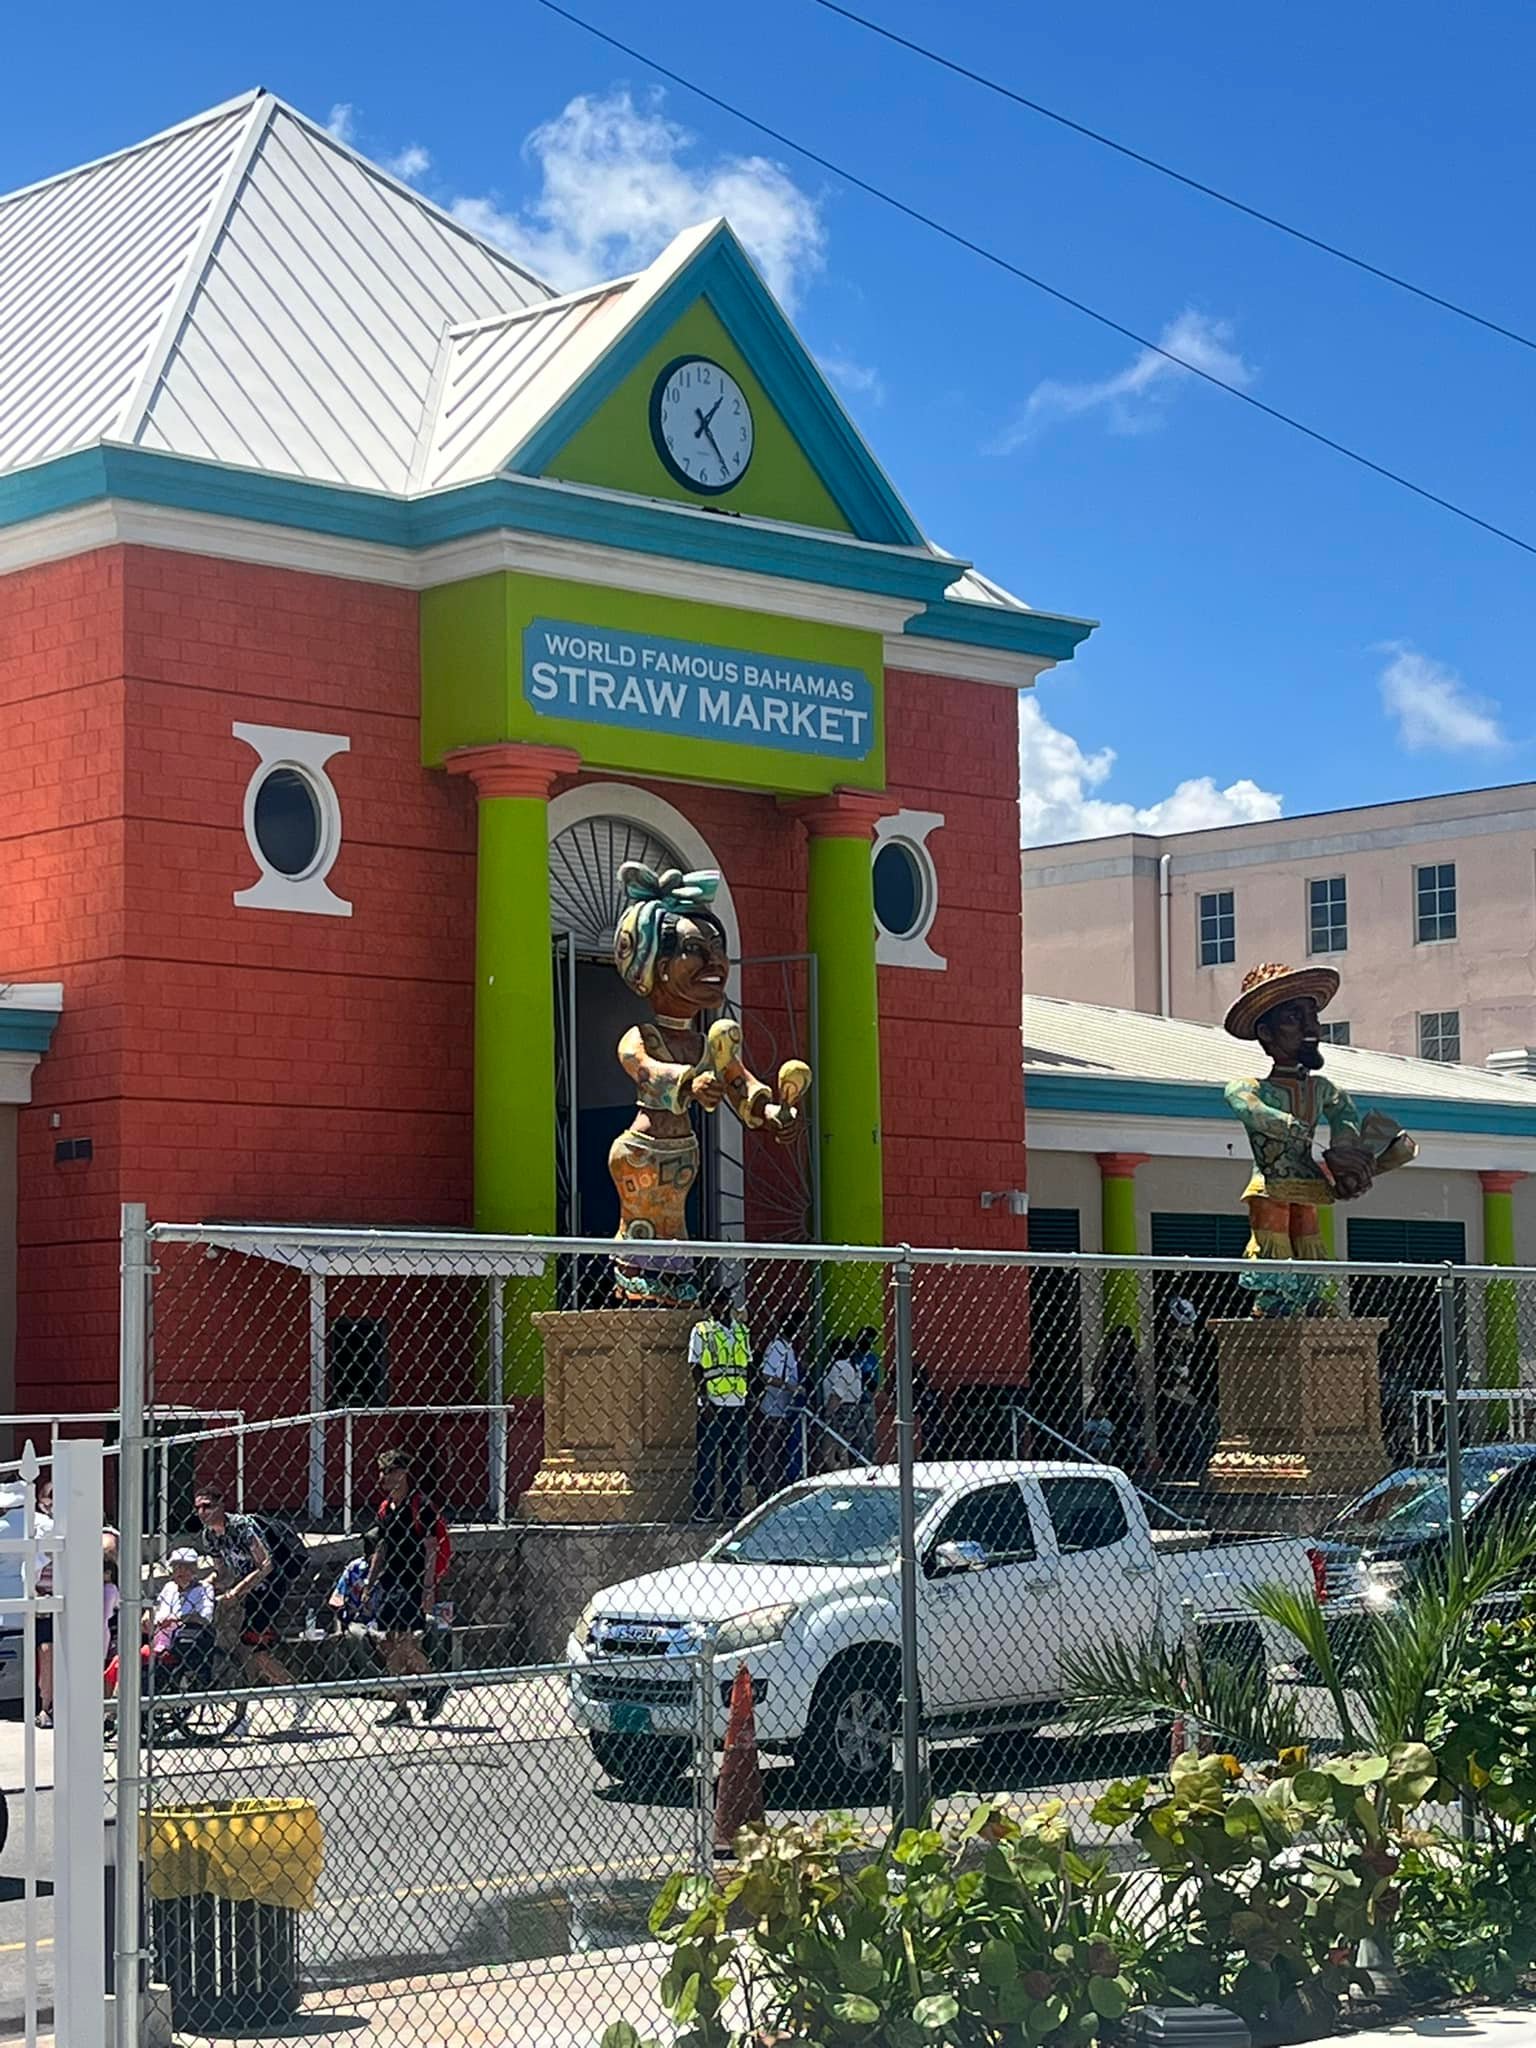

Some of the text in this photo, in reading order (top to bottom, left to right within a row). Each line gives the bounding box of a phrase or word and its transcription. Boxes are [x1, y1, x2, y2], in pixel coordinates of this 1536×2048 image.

[679, 371, 690, 388] 11
[697, 366, 711, 385] 12
[720, 378, 724, 394] 1
[666, 386, 681, 404] 10
[733, 399, 741, 415] 2
[740, 427, 746, 442] 3
[683, 457, 690, 472] 7
[732, 451, 740, 466] 4
[699, 467, 708, 482] 6
[719, 464, 728, 482] 5
[544, 633, 854, 701] WORLD FAMOUS BAHAMAS
[531, 662, 868, 745] STRAW MARKET
